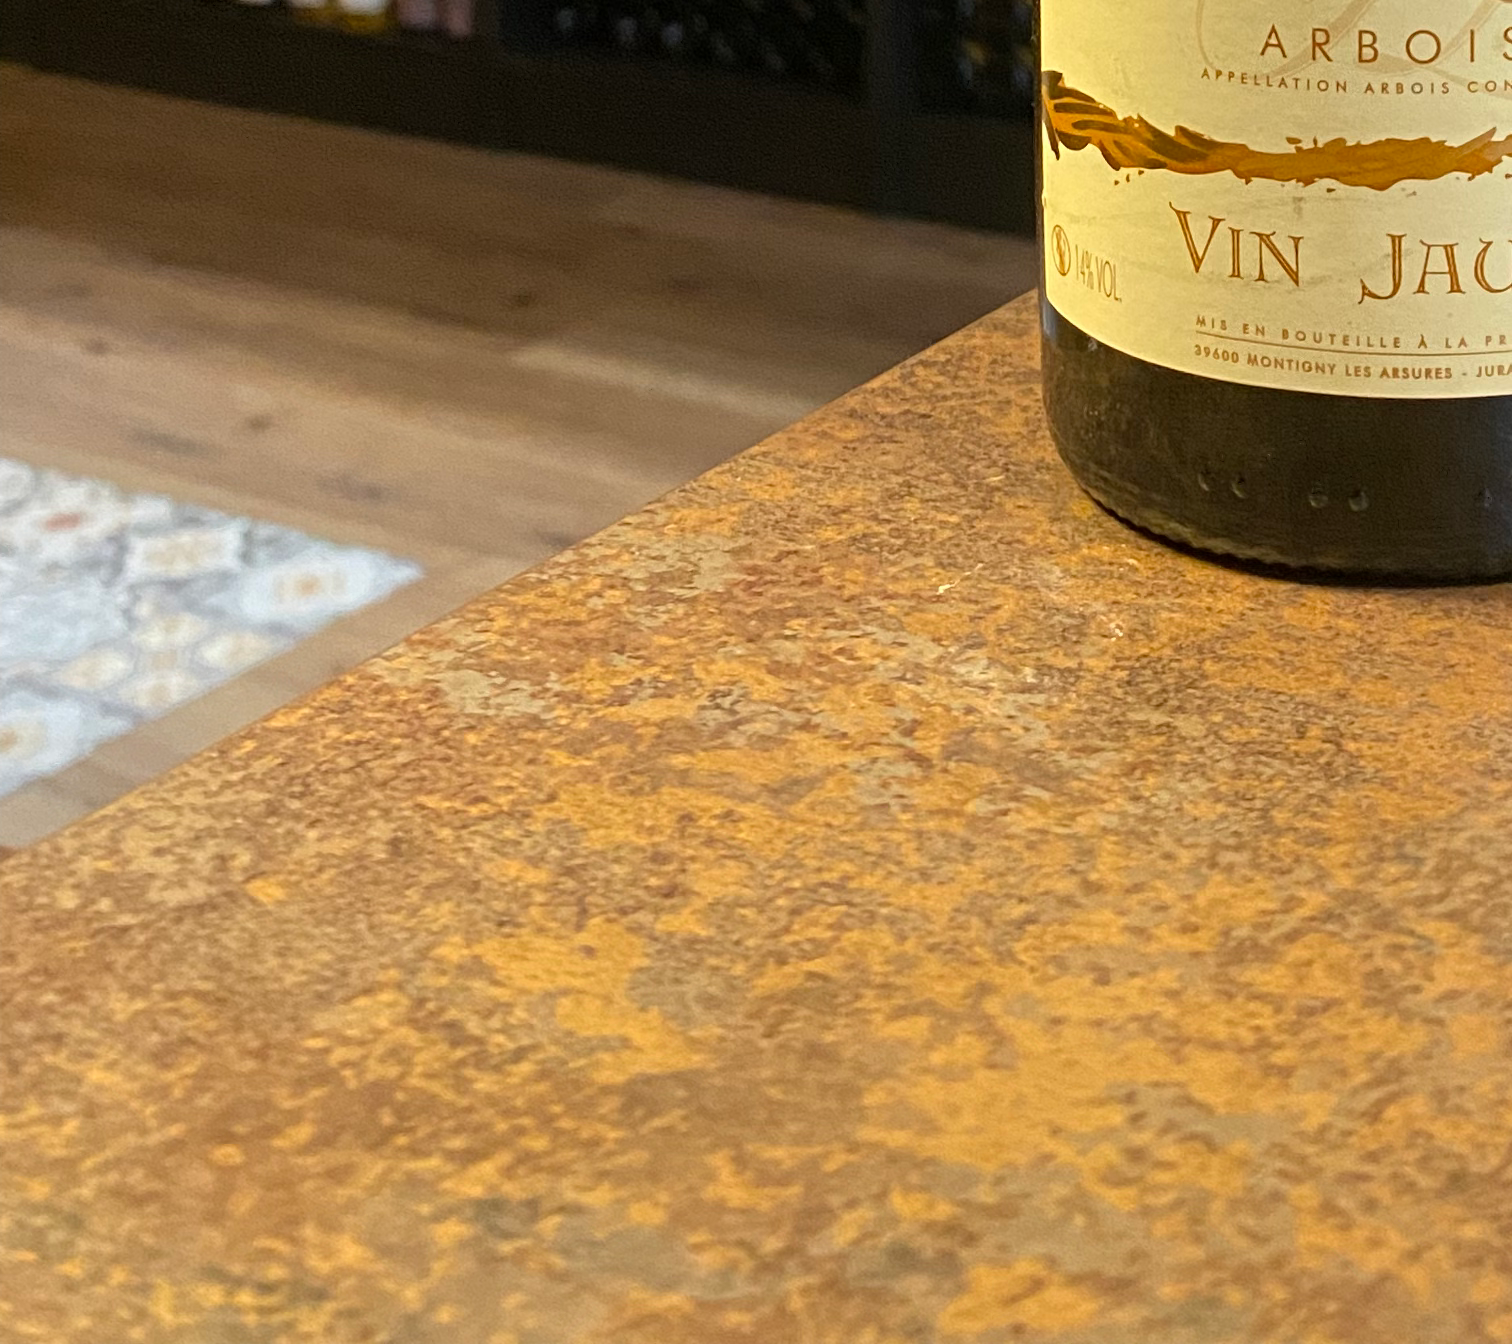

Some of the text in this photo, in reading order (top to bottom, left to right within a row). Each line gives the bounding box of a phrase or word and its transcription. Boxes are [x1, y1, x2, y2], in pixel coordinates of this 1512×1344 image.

[1200, 66, 1349, 95] APPELLATION
[1364, 81, 1450, 95] ARBOIS
[1168, 201, 1305, 288] VIN
[1195, 315, 1228, 331] MIS
[1242, 323, 1266, 337] EN
[1281, 328, 1402, 349] BOUTEILLE
[1444, 336, 1468, 349] LA
[1194, 343, 1240, 364] 39600
[1247, 353, 1337, 376] MONTIGNY
[1345, 365, 1372, 378] LES
[1379, 366, 1453, 380] ARSURES
